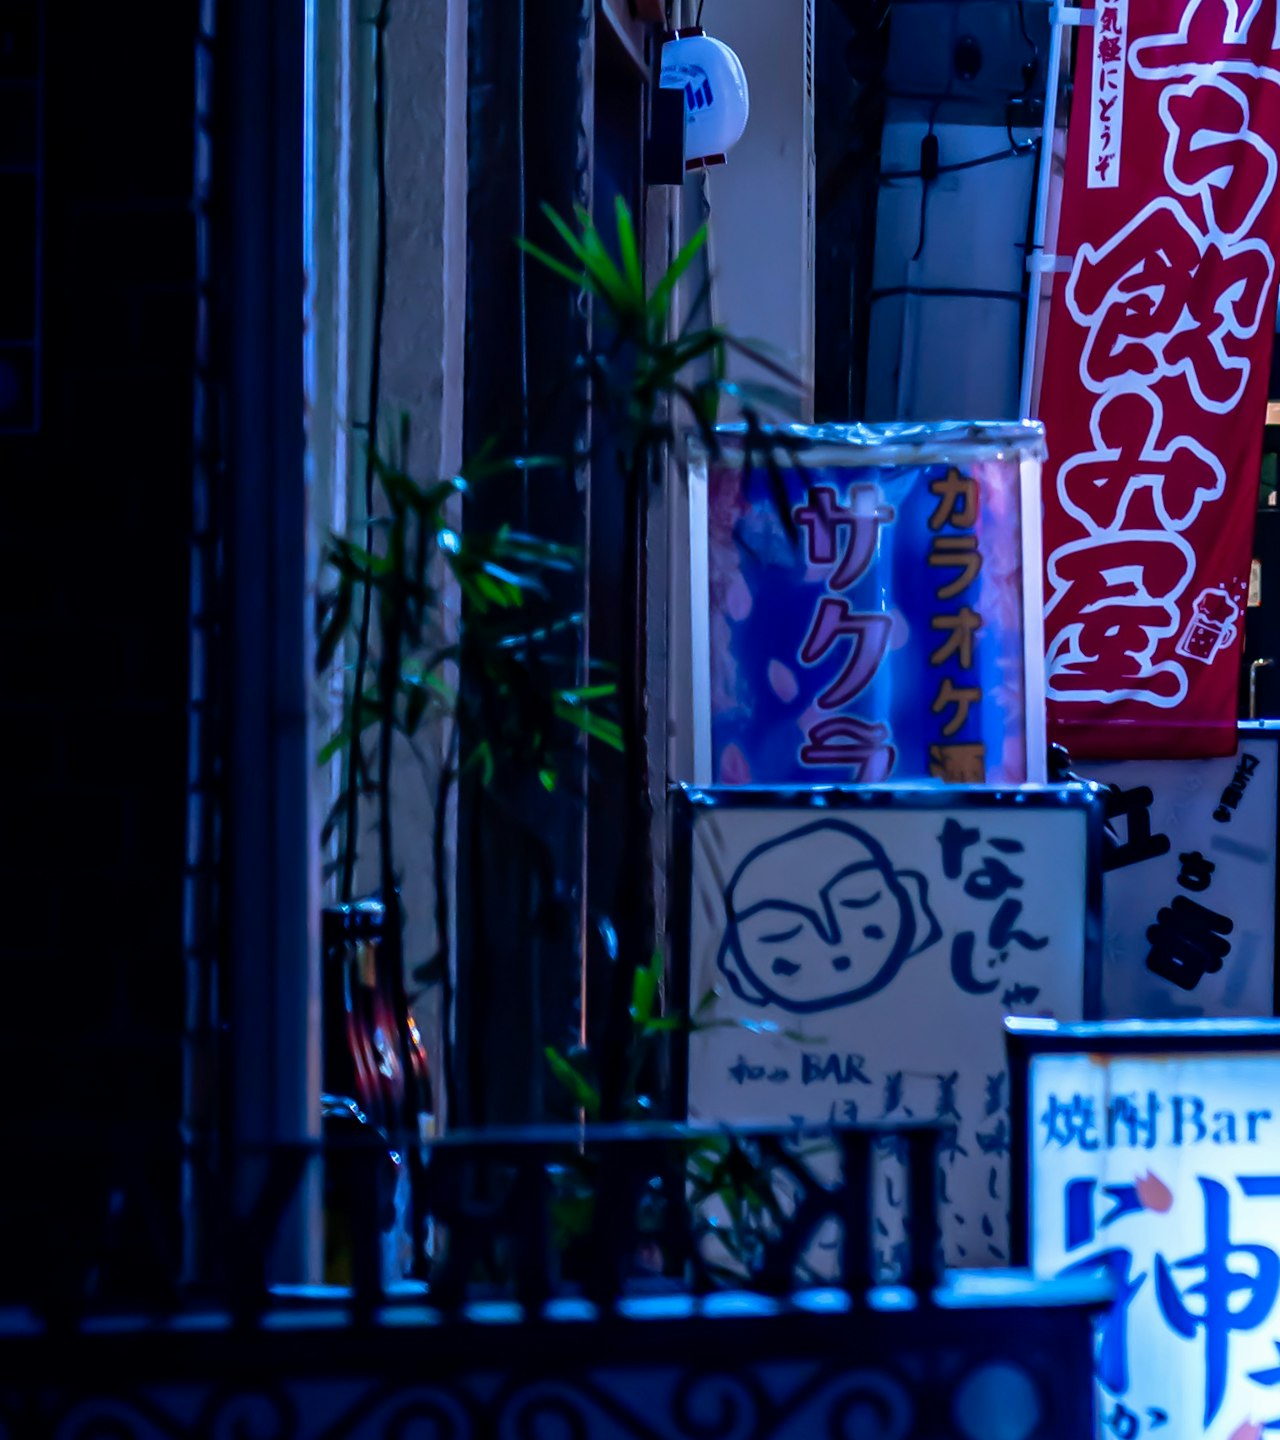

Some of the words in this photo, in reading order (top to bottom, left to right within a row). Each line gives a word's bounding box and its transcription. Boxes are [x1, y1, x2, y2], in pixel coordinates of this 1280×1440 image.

[798, 483, 896, 784] サクラ
[802, 1052, 872, 1085] BAR
[1041, 1092, 1271, 1149] 焼酎Bar
